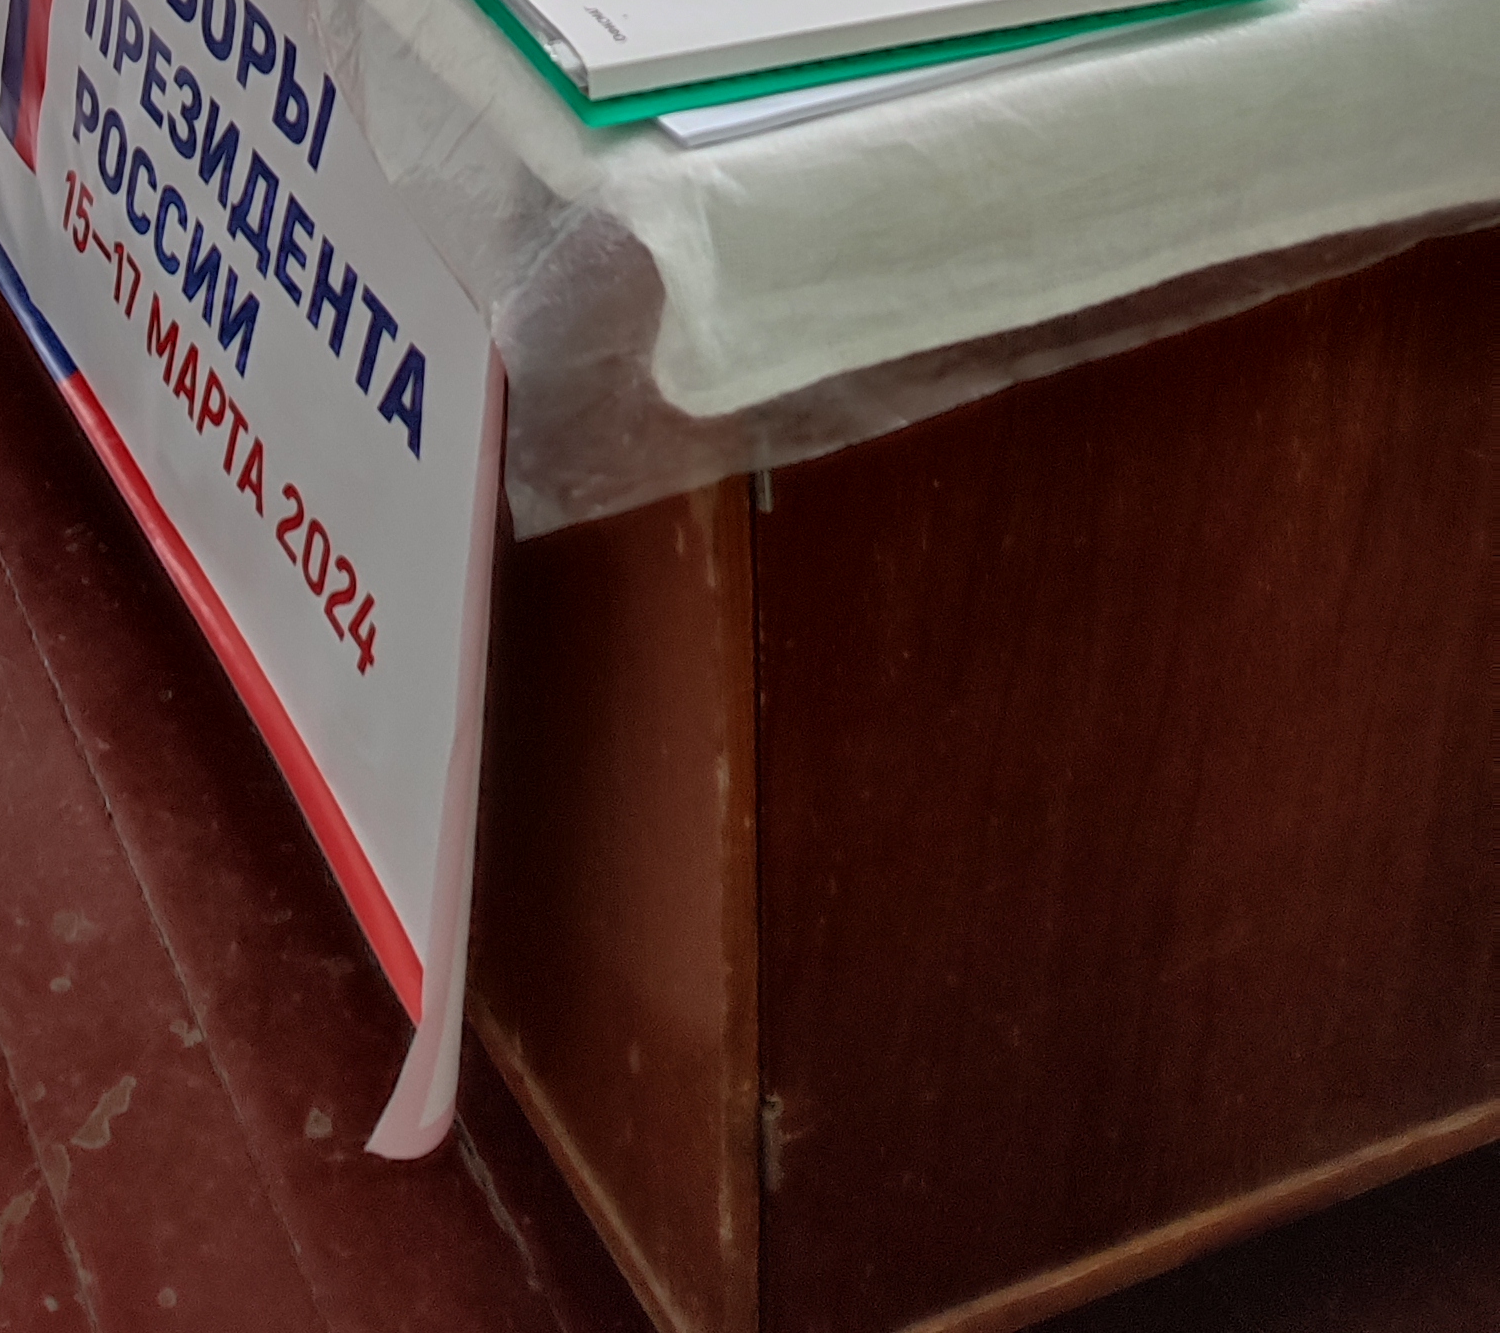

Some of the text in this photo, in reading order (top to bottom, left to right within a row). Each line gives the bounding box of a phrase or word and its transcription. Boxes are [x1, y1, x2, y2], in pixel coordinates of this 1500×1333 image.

[72, 65, 260, 379] РОССИИ
[146, 290, 264, 518] МАРТА
[275, 482, 377, 676] 2024
